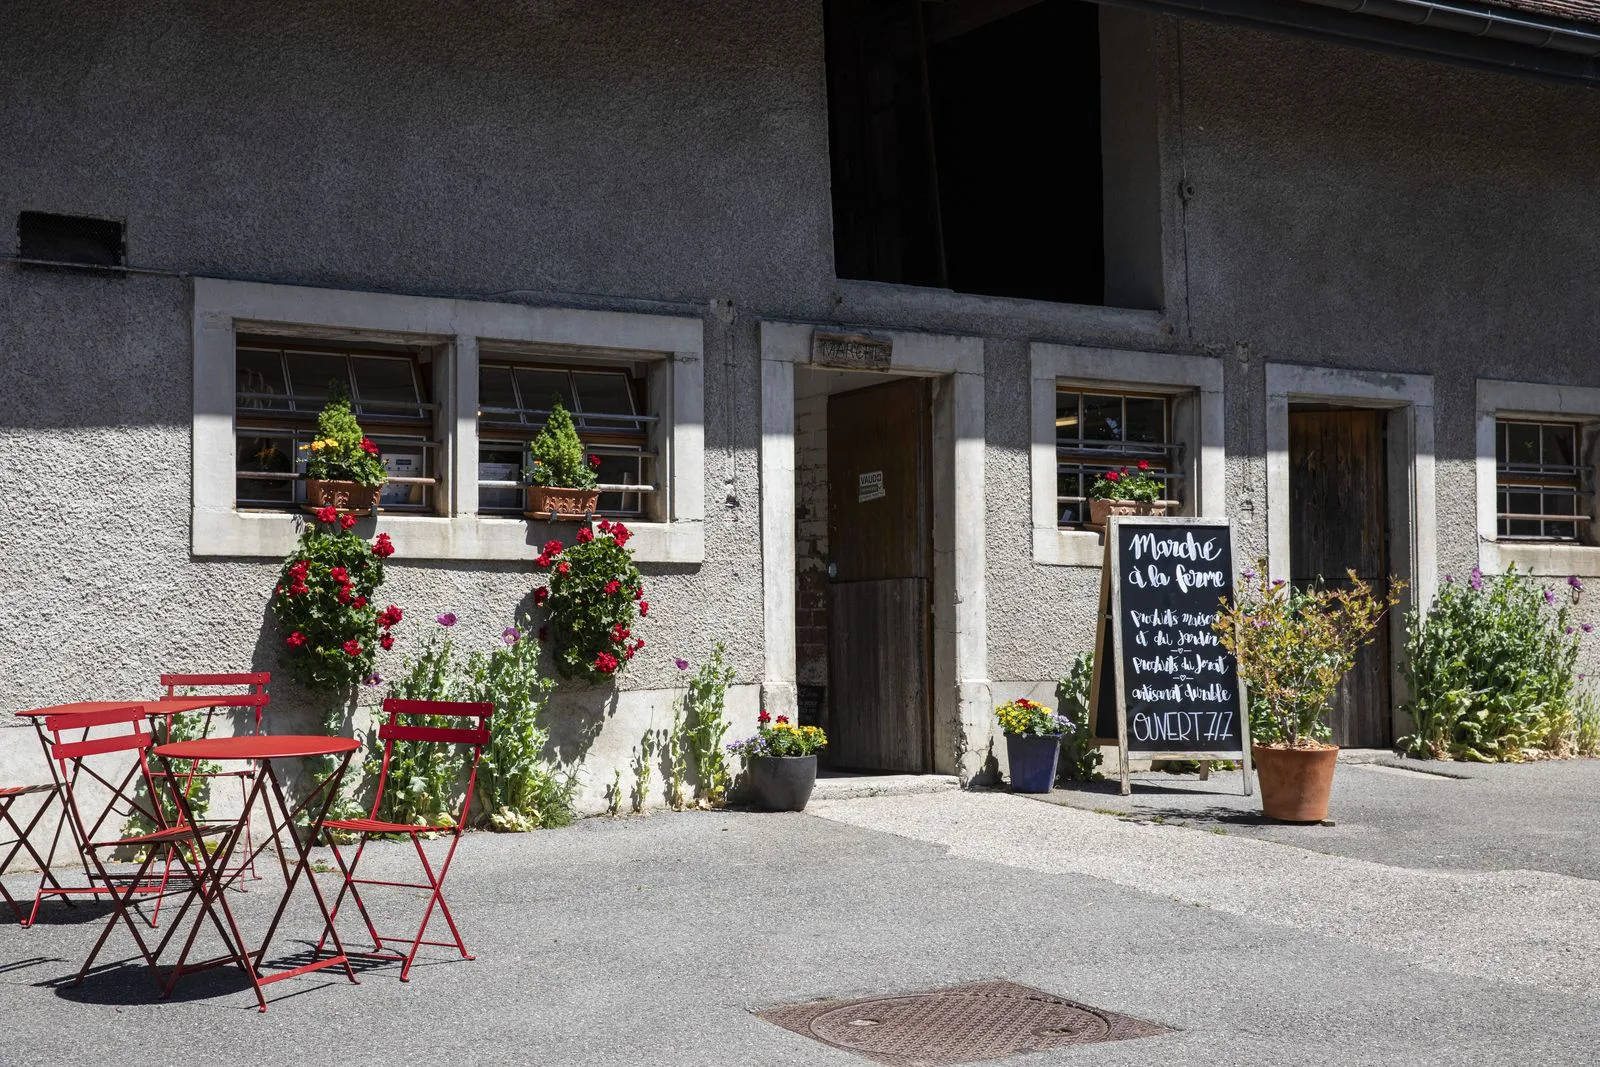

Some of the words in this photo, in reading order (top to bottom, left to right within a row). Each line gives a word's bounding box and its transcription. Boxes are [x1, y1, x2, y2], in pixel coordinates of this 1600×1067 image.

[1128, 531, 1222, 561] Marché
[1128, 565, 1147, 589] à
[1147, 564, 1171, 588] la
[1175, 564, 1225, 594] ferme
[1135, 630, 1149, 647] et
[1153, 630, 1173, 646] du
[1180, 656, 1196, 671] du
[1131, 683, 1184, 703] artisanat
[1184, 683, 1232, 703] durable
[1133, 711, 1204, 742] OUVERT
[1203, 711, 1234, 741] 7/7
